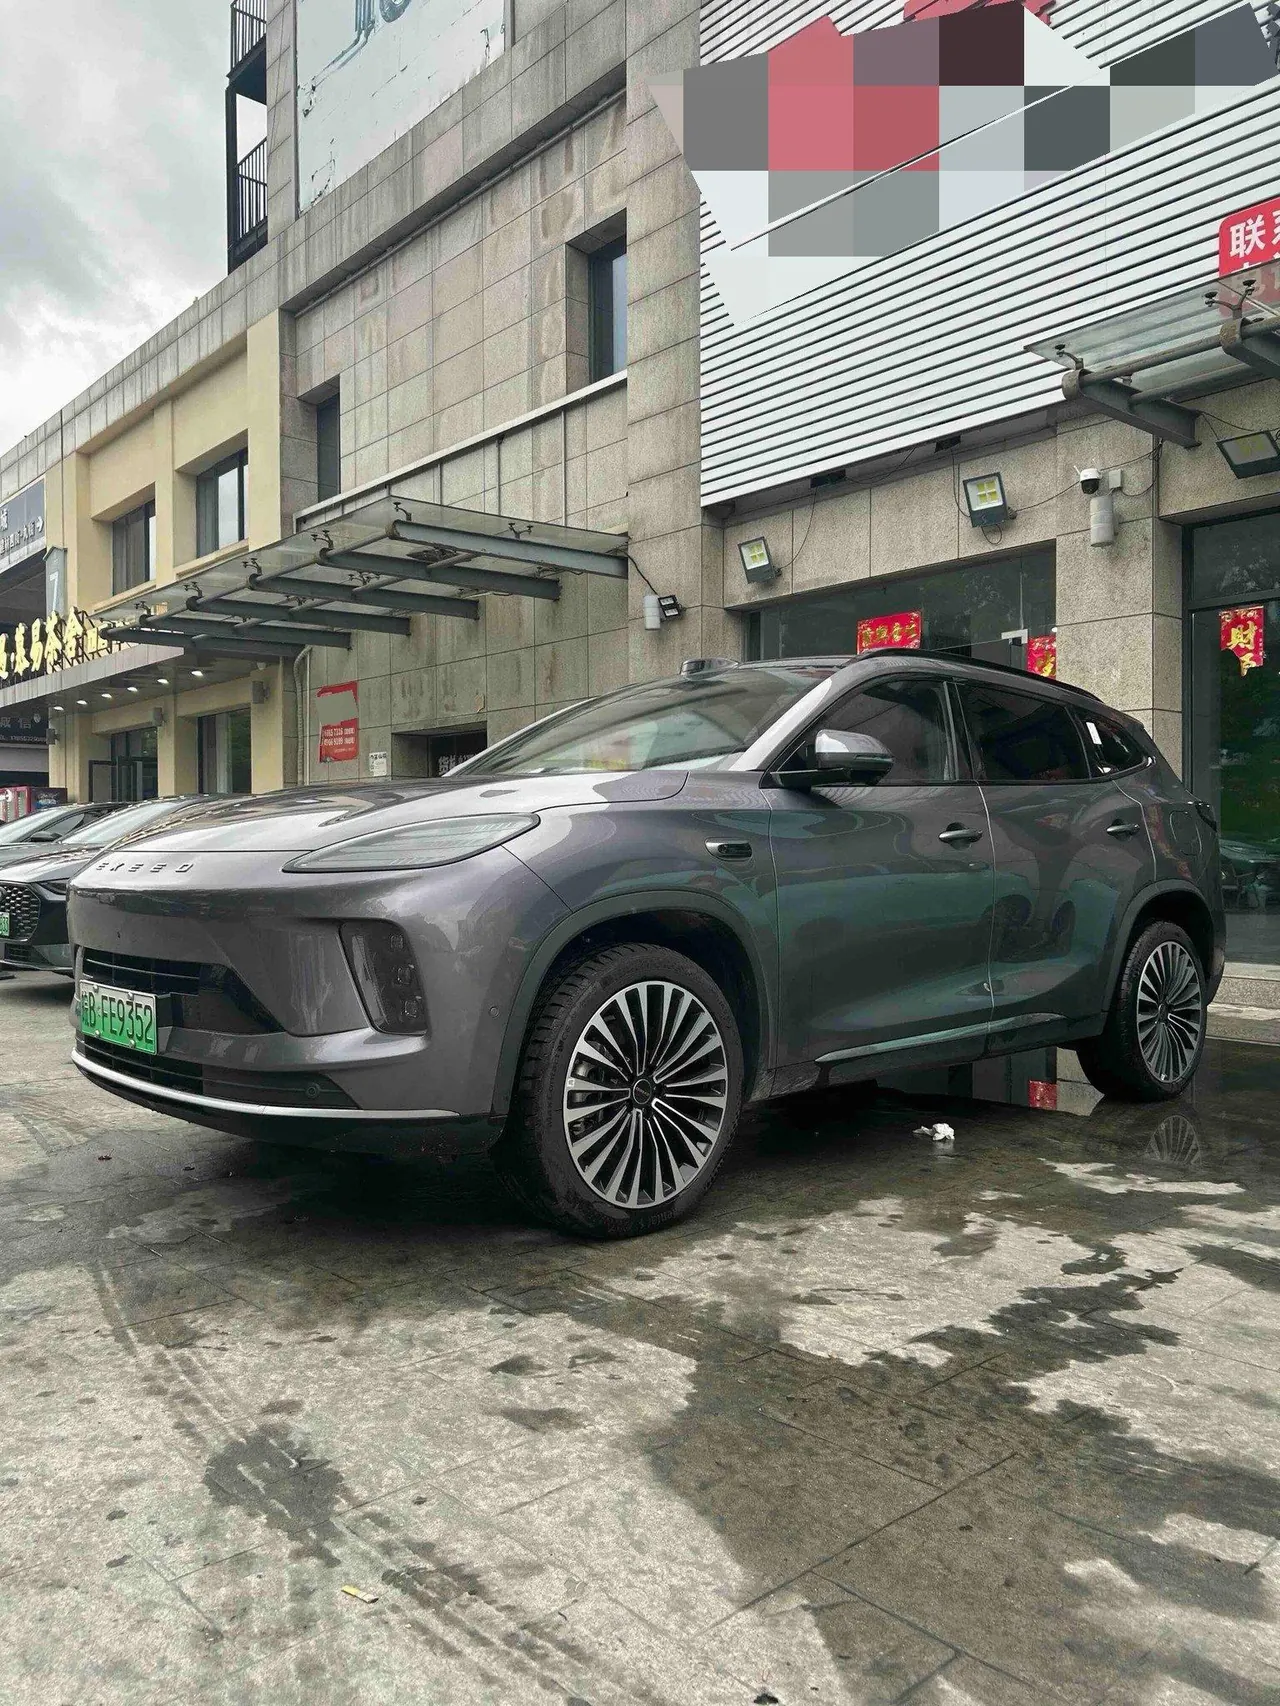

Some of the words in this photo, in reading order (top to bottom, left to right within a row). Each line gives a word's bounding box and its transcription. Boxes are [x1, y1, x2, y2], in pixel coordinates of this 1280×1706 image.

[1230, 210, 1280, 258] 联
[49, 571, 59, 611] 7
[96, 862, 195, 873] EXEED
